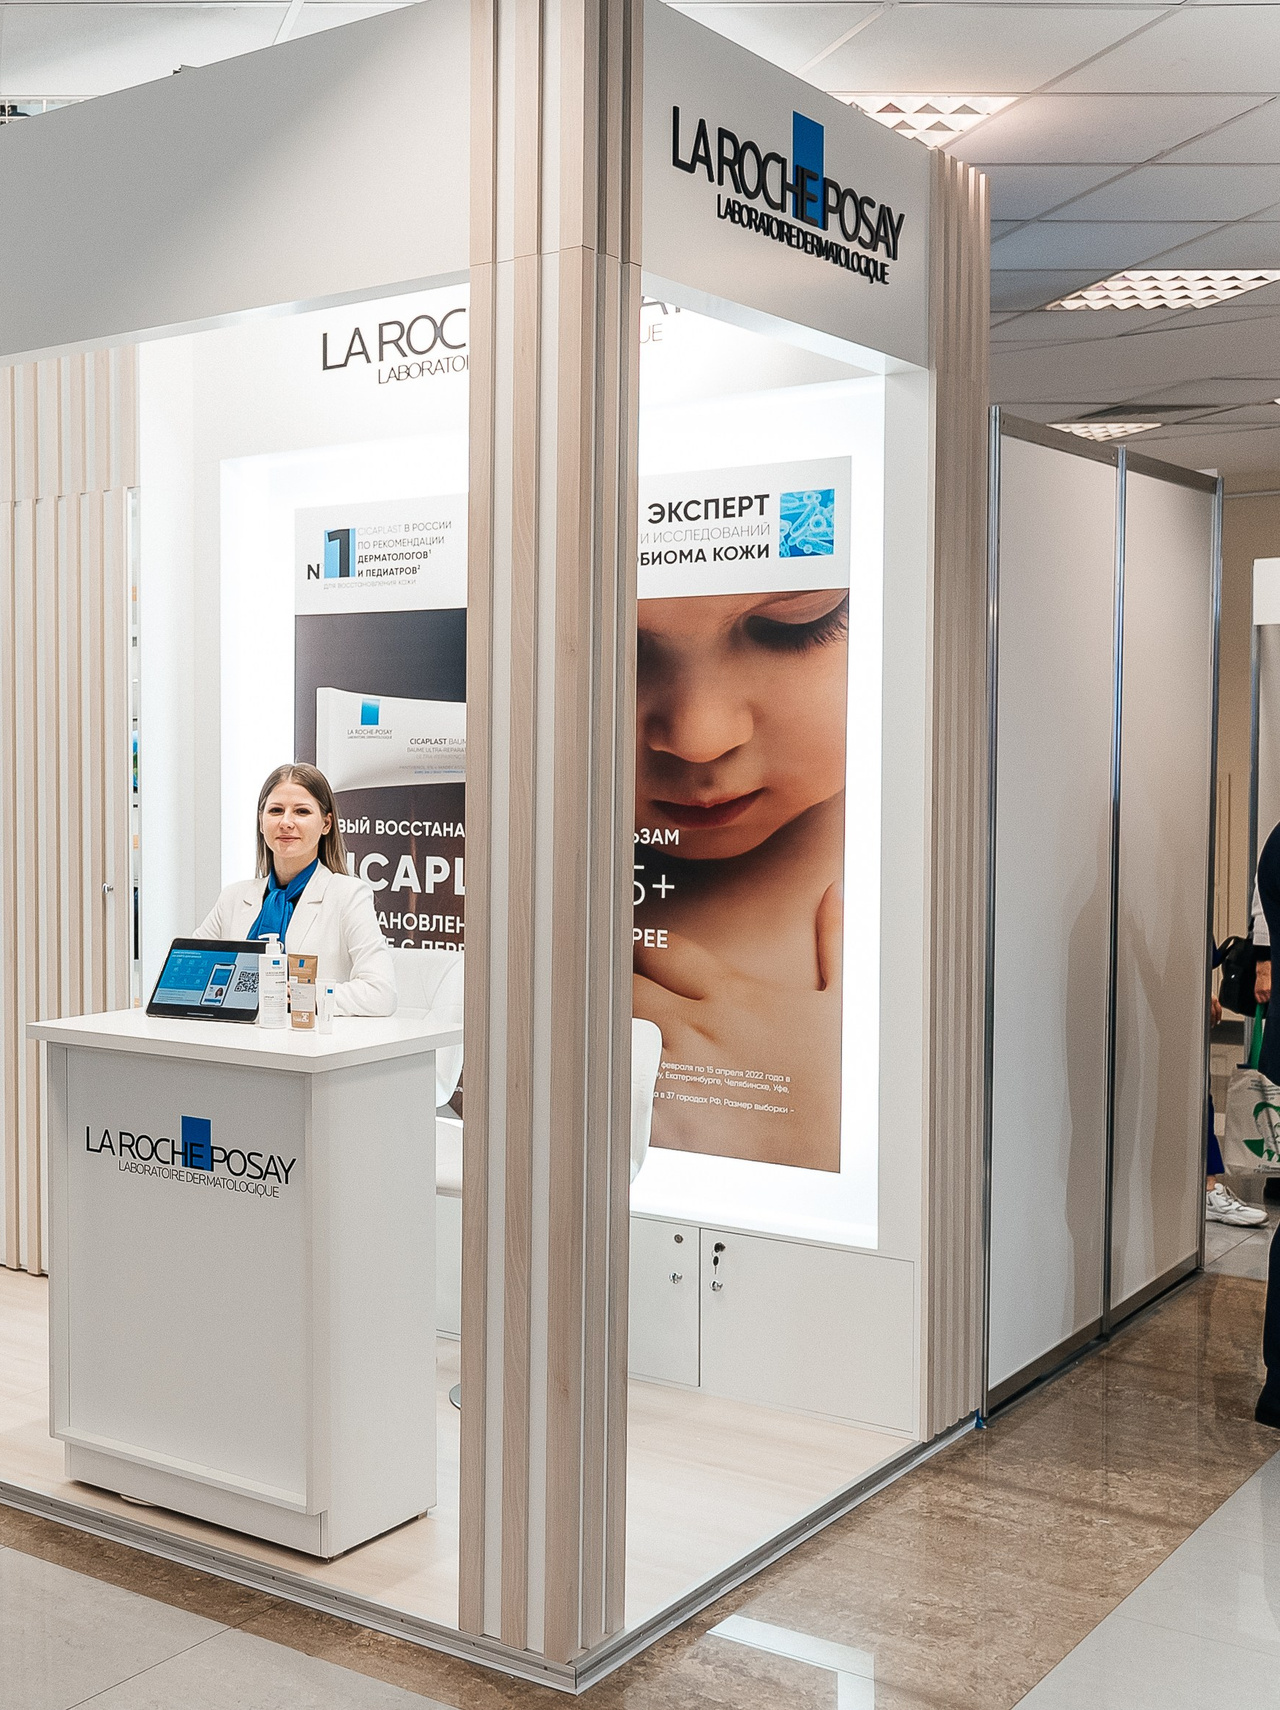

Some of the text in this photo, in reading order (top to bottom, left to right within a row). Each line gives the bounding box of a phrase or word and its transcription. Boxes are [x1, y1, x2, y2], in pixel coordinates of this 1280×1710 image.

[672, 105, 906, 261] LA ROCHE POSAY
[322, 308, 467, 371] LA ROC
[378, 355, 469, 385] LABORATOI
[647, 493, 770, 524] ЭКСПЕРТ
[412, 521, 452, 531] РОССИИ
[653, 522, 770, 544] ИССЛЕДОВАНИЙ
[358, 536, 445, 550] ПО РЕКОМЕНДАЦИИ
[637, 543, 770, 566] БИОМА КОЖИ
[338, 816, 465, 838] ВЫЙ ВОССТАНА
[346, 852, 465, 896] ICAPL
[377, 911, 465, 934] АНОВЛЕН
[632, 928, 668, 949] РЕЕ
[661, 1061, 694, 1072] февраля
[695, 1065, 705, 1073] по
[706, 1065, 714, 1074] 15
[715, 1068, 744, 1077] апреля
[745, 1071, 764, 1080] 2022
[765, 1074, 784, 1083] года
[666, 1091, 675, 1100] 37
[676, 1094, 708, 1104] городах
[724, 1099, 753, 1109] Размер
[754, 1102, 788, 1114] выборки
[86, 1125, 297, 1185] LA ROCHE POSAY
[118, 1160, 280, 1199] LABORATOIRE DERMATOLOGIQUE
